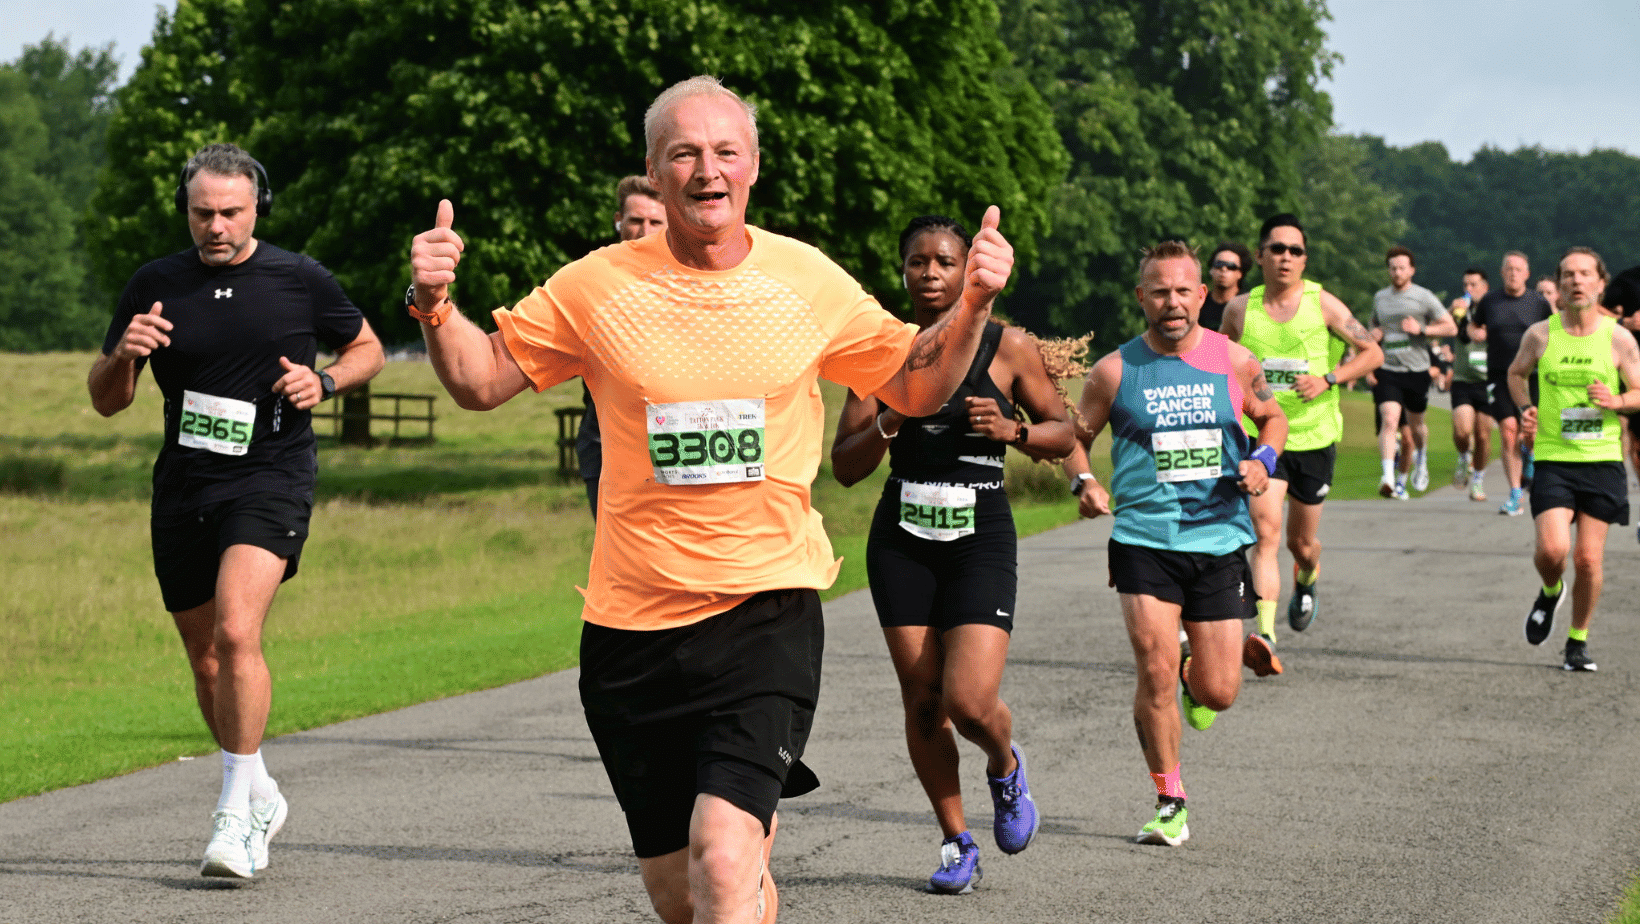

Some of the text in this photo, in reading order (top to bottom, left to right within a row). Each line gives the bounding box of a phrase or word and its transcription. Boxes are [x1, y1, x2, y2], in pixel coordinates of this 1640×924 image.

[1560, 356, 1592, 364] Alan
[1143, 383, 1215, 401] OVARIAN
[1146, 397, 1212, 414] CANCER
[181, 410, 249, 444] 2365
[1155, 410, 1216, 428] ACTION
[653, 429, 761, 467] 3308
[1156, 447, 1219, 471] 3252
[904, 503, 969, 529] 2415
